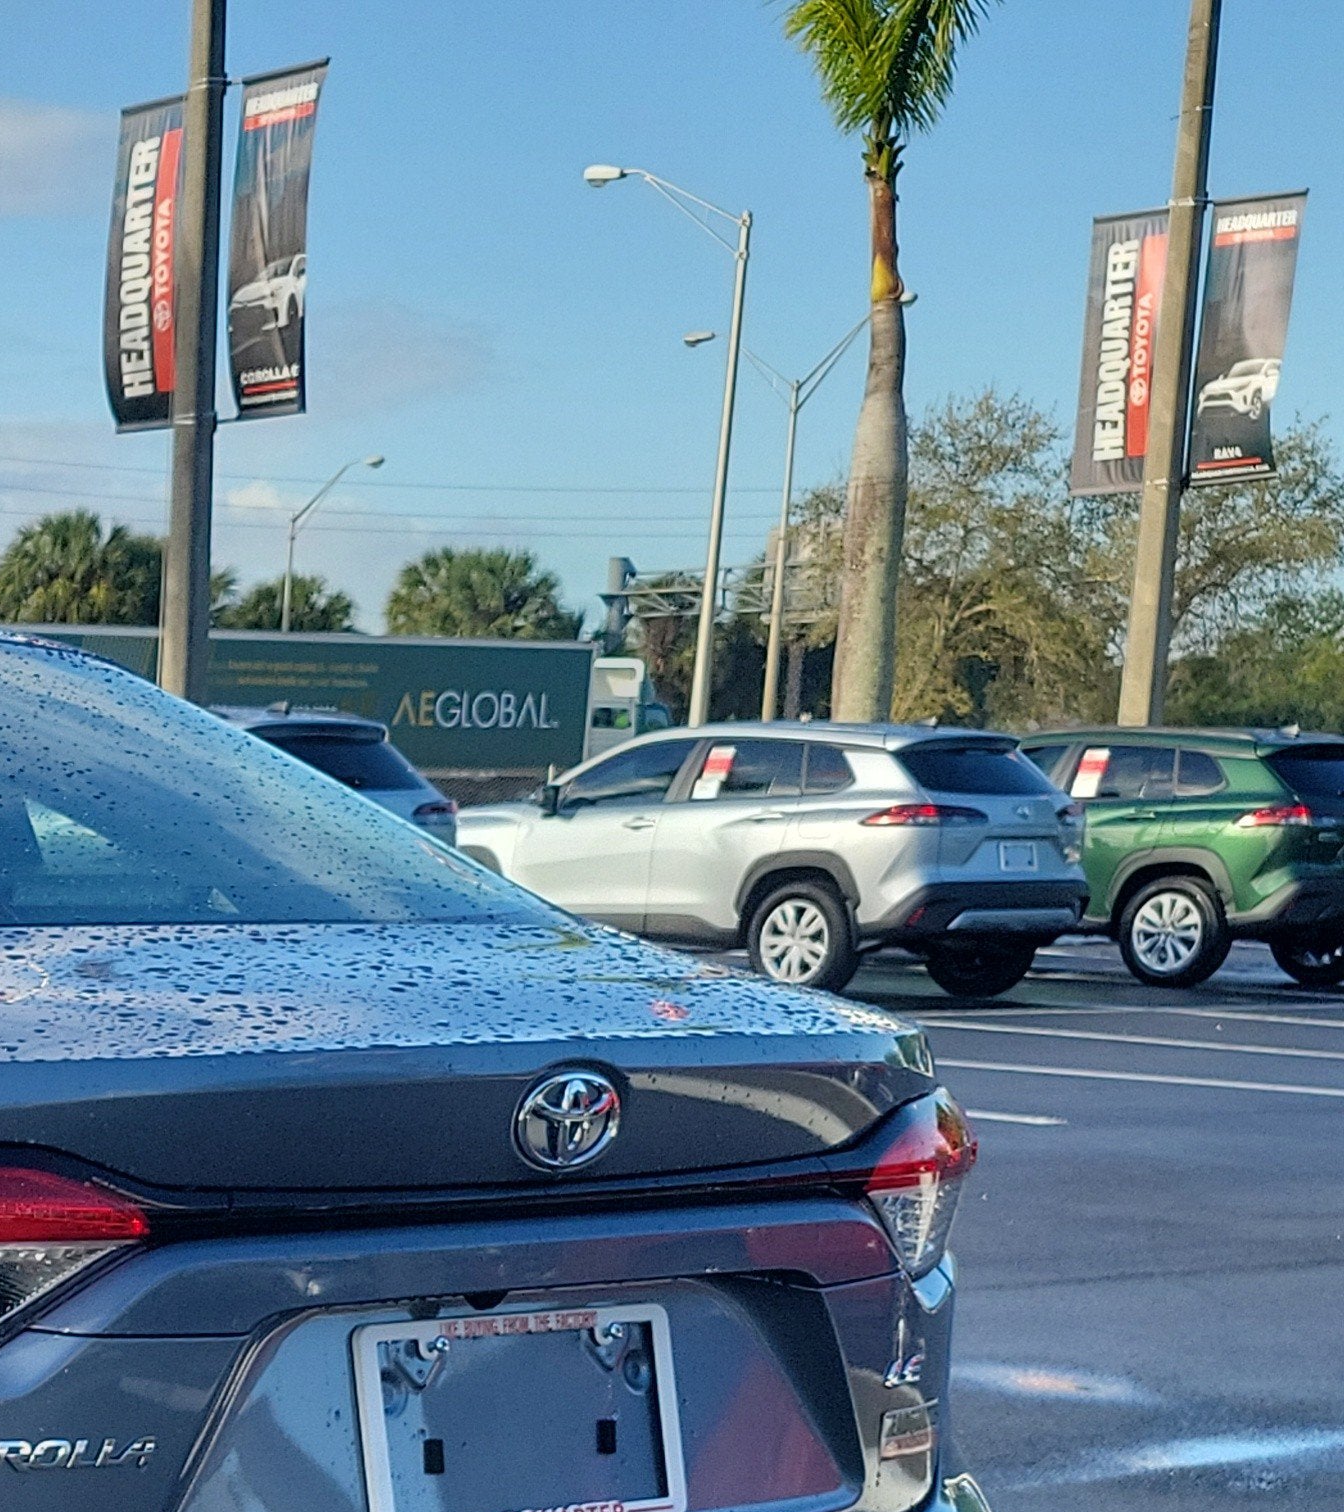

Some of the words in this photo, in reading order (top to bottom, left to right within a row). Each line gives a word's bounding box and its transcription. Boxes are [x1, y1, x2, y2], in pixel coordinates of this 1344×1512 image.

[120, 136, 161, 398] HEADQUARTER
[154, 198, 173, 299] TOYOTA
[1216, 209, 1298, 234] HEADQUARTER
[1093, 238, 1140, 461] HEADQUARTER
[1132, 292, 1154, 378] TOYOTA
